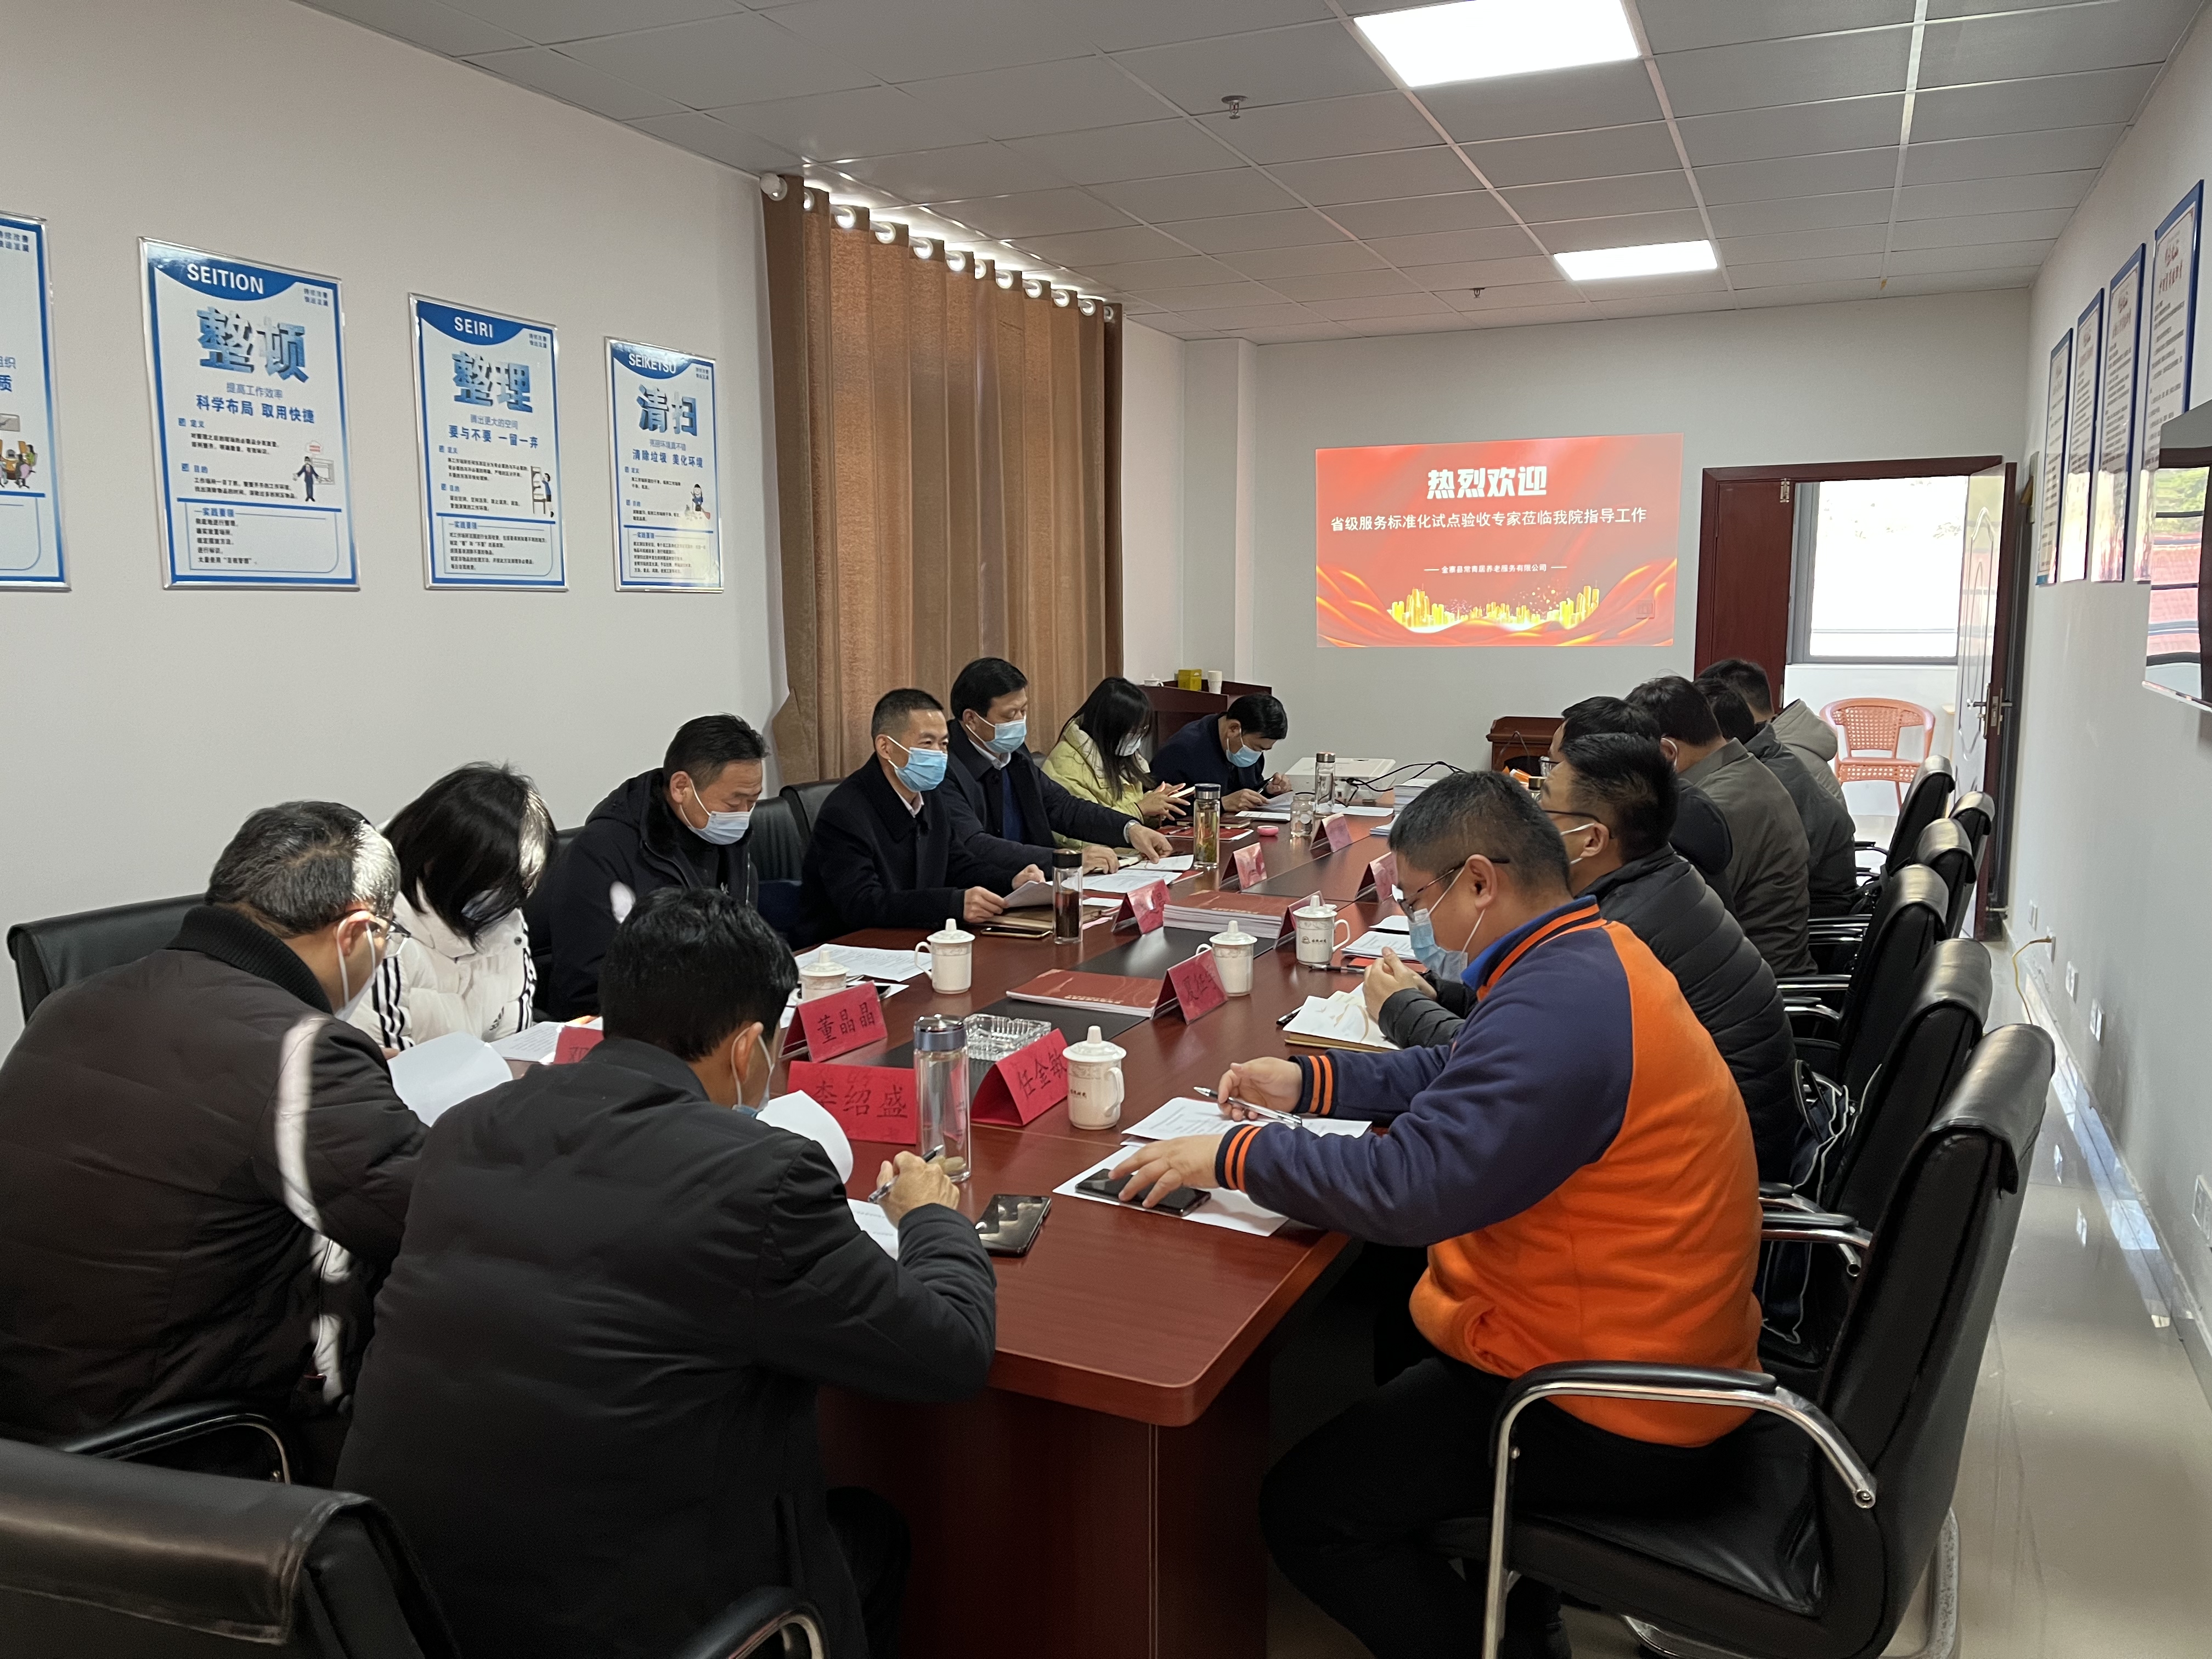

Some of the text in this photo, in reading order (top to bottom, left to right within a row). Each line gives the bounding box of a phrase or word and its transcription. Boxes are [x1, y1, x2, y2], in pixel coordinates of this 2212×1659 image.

[187, 263, 264, 294] SEITION
[454, 317, 494, 338] SEIRI
[196, 306, 309, 383] 整顿
[227, 382, 283, 399] 提高工作效率
[452, 351, 533, 413] 整理
[196, 394, 315, 424] 科学布局 取用快捷
[636, 383, 697, 437] 清扫
[448, 425, 538, 449] 要与不要 一留一弃
[633, 449, 667, 463] 清除垃圾
[1426, 466, 1547, 500] 热烈欢迎
[1330, 507, 1647, 532] 省级服务标准化试点验收专家莅临我院指导工作
[817, 1002, 875, 1045] 董晶晶
